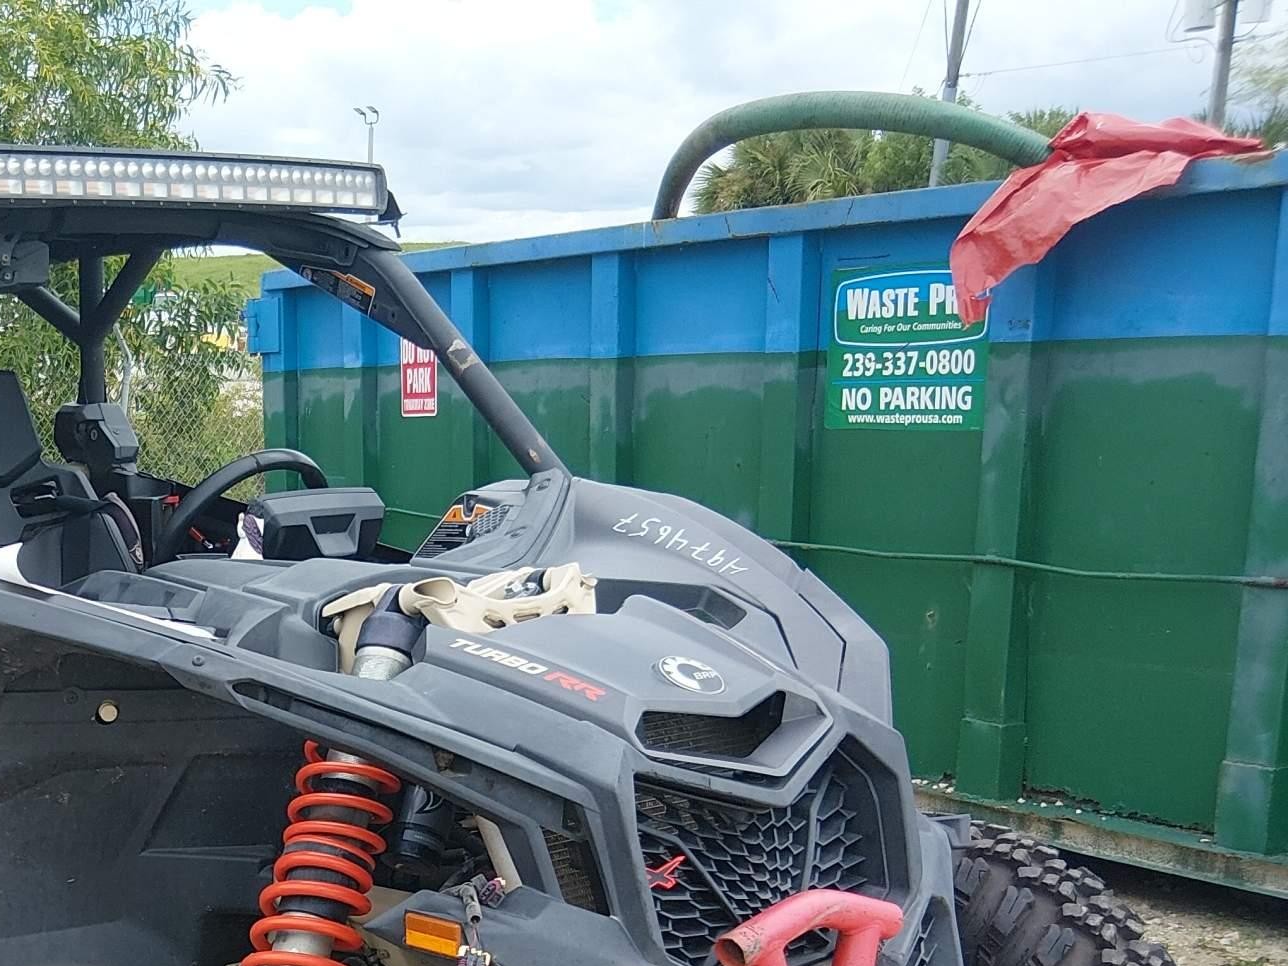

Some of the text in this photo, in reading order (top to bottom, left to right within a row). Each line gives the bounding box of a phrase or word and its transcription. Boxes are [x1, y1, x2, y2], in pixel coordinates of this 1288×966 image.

[847, 283, 959, 320] WASTE PR
[860, 320, 962, 334] Caring For Our Communities
[842, 349, 975, 377] 239-337-0800
[407, 367, 431, 393] PARK
[841, 385, 972, 411] NO PARKING
[848, 413, 963, 426] www.wasteprousa.com
[448, 638, 607, 702] TURBO RR
